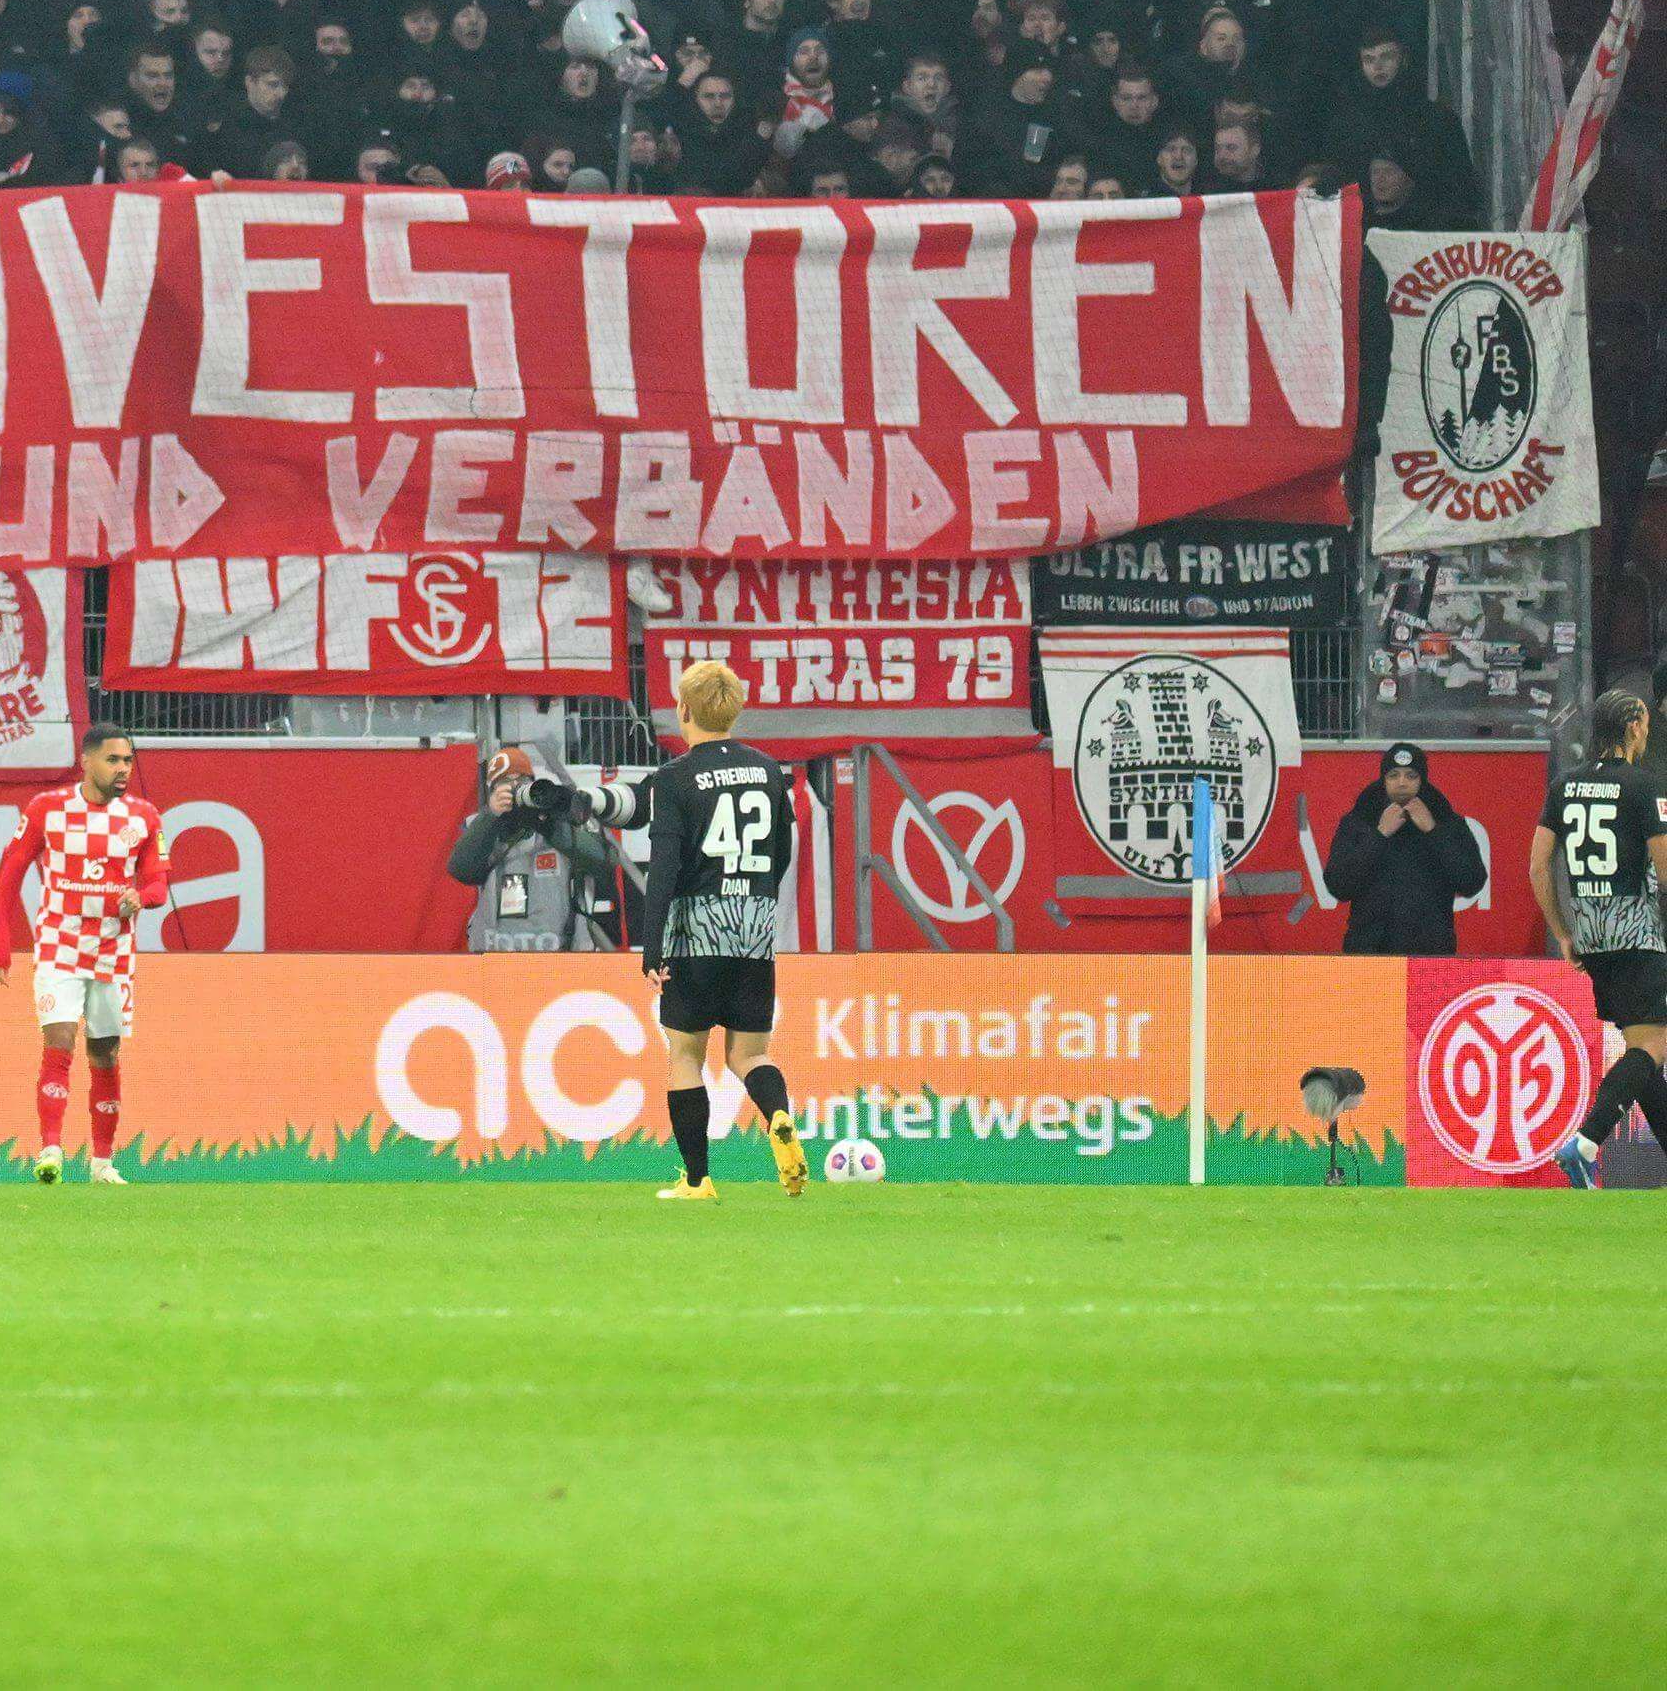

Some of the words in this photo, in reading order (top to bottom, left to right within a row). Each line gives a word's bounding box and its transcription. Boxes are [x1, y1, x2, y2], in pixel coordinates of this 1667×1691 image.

[1386, 240, 1565, 317] FREIBURGER
[325, 419, 1141, 555] VERBÄNDEN
[1391, 437, 1566, 522] BOTSCHAFT
[649, 557, 1024, 623] SYNTHESIA
[1049, 540, 1169, 583] ULTRA
[1178, 537, 1334, 585] FR-WEST
[937, 635, 1013, 701] 79
[695, 770, 714, 790] SC
[713, 766, 768, 787] FREIBURG
[1563, 782, 1576, 798] SC
[1576, 782, 1621, 799] FREIBURG
[701, 790, 772, 874] 42
[1562, 803, 1618, 876] 25
[815, 993, 1151, 1060] Klimafair
[789, 1087, 1153, 1156] unterwegs
